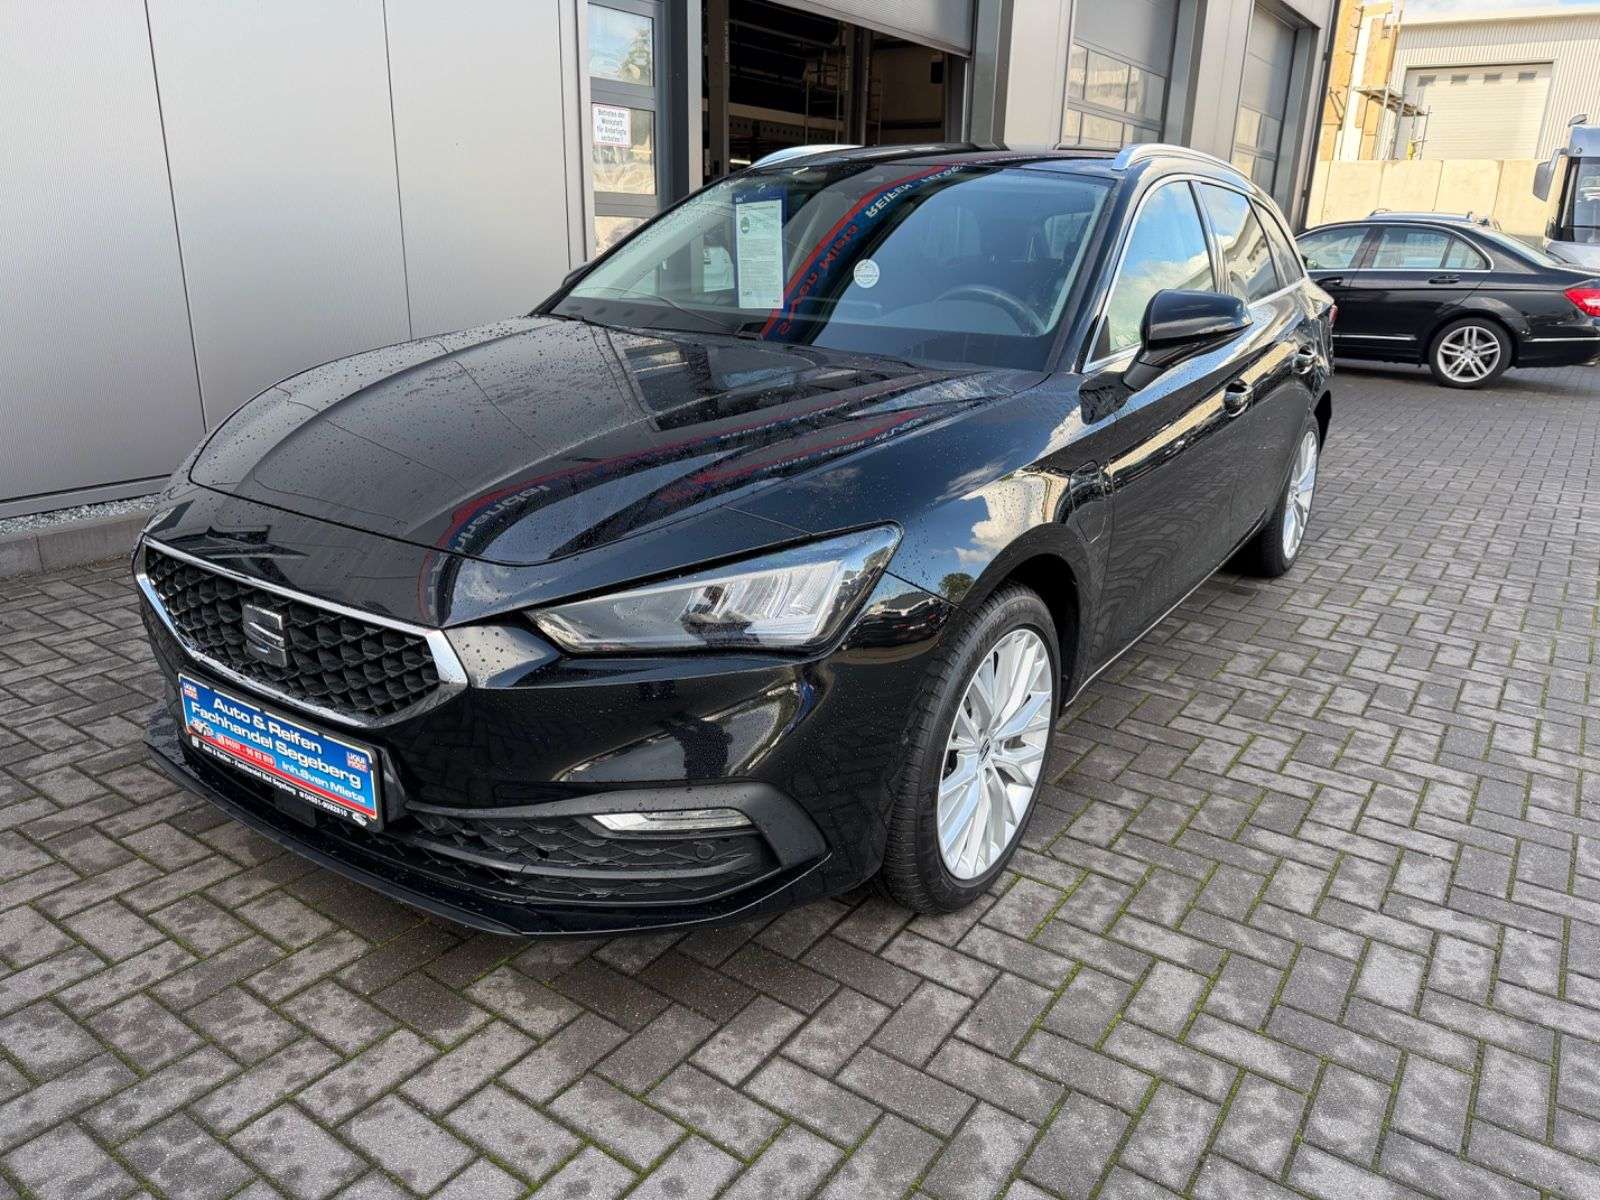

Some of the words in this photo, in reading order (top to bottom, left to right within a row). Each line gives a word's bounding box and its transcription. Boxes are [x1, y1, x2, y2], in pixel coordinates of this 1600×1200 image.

[191, 701, 273, 749] Fachhandel
[275, 740, 361, 789] Segeberg
[213, 698, 251, 724] Auto
[253, 715, 267, 730] &
[268, 720, 322, 754] Reifen
